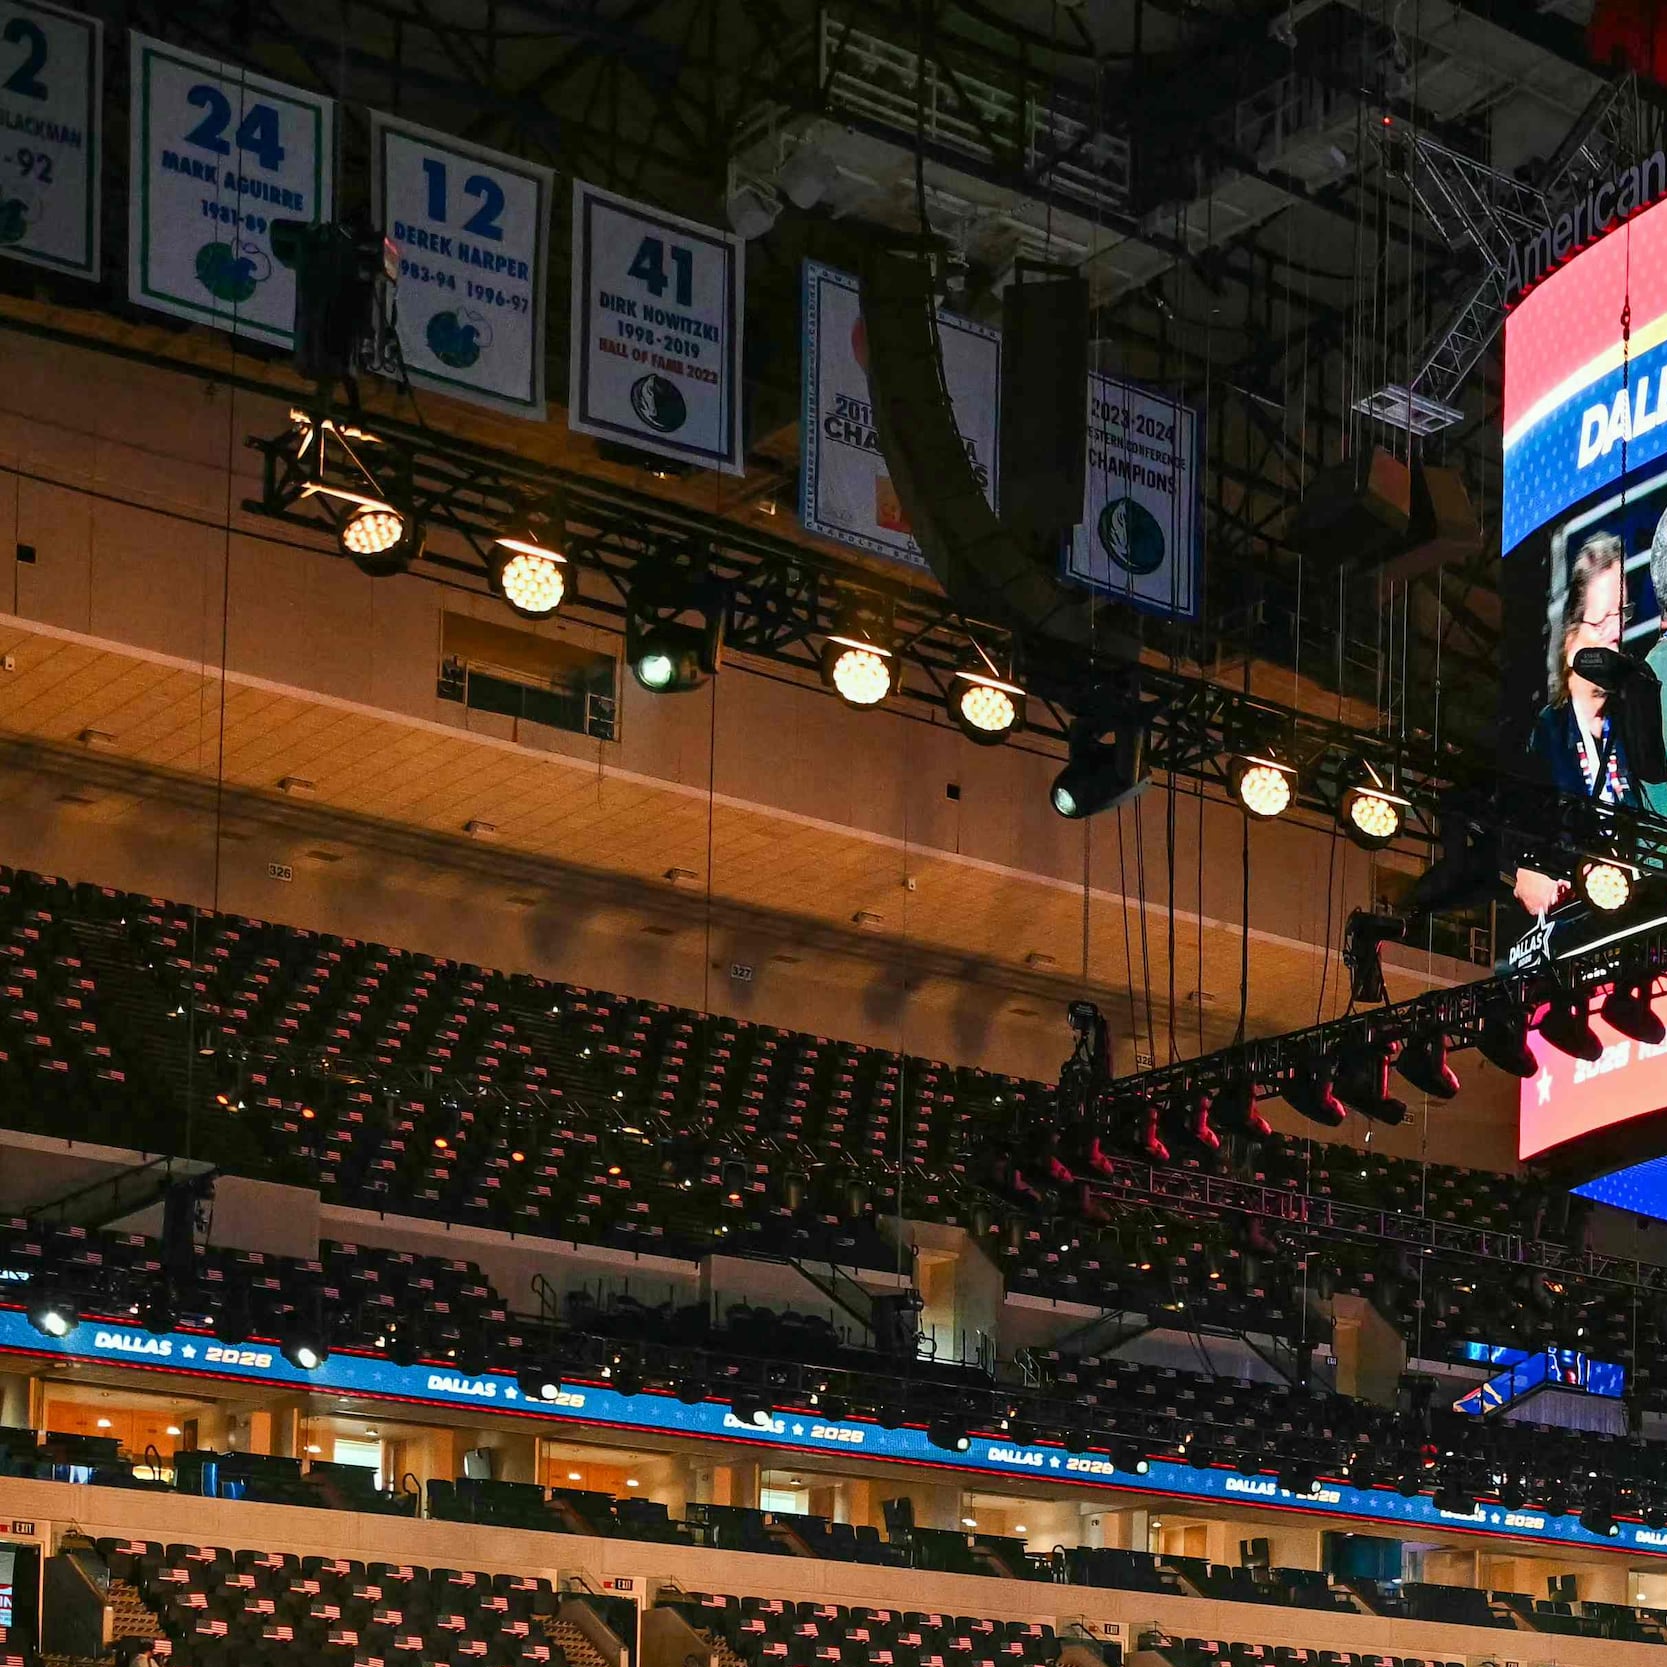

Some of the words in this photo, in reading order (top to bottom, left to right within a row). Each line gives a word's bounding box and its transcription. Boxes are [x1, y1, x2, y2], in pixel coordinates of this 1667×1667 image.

[0, 106, 82, 148] LACKMAN
[184, 85, 284, 171] 24
[161, 150, 219, 184] MARK
[223, 171, 304, 212] AGUIRRE
[422, 157, 505, 241] 12
[394, 221, 452, 258] DEREK
[458, 243, 529, 282] HARPER
[627, 236, 693, 307] 41
[396, 258, 456, 292] 983-94
[466, 279, 529, 313] 1996-97
[600, 290, 637, 318] DIRK
[643, 303, 719, 344] NOWITZKI
[616, 319, 700, 359] 1998-2019
[1088, 449, 1175, 495] CHAMPIONS
[1508, 932, 1543, 966] DALLAS
[95, 1331, 173, 1357] DALLAS
[205, 1346, 273, 1368] 2026
[427, 1375, 497, 1398] DALLAS
[988, 1447, 1044, 1467] DALLAS
[1066, 1457, 1114, 1475] 2026
[1226, 1478, 1276, 1496] DALLAS
